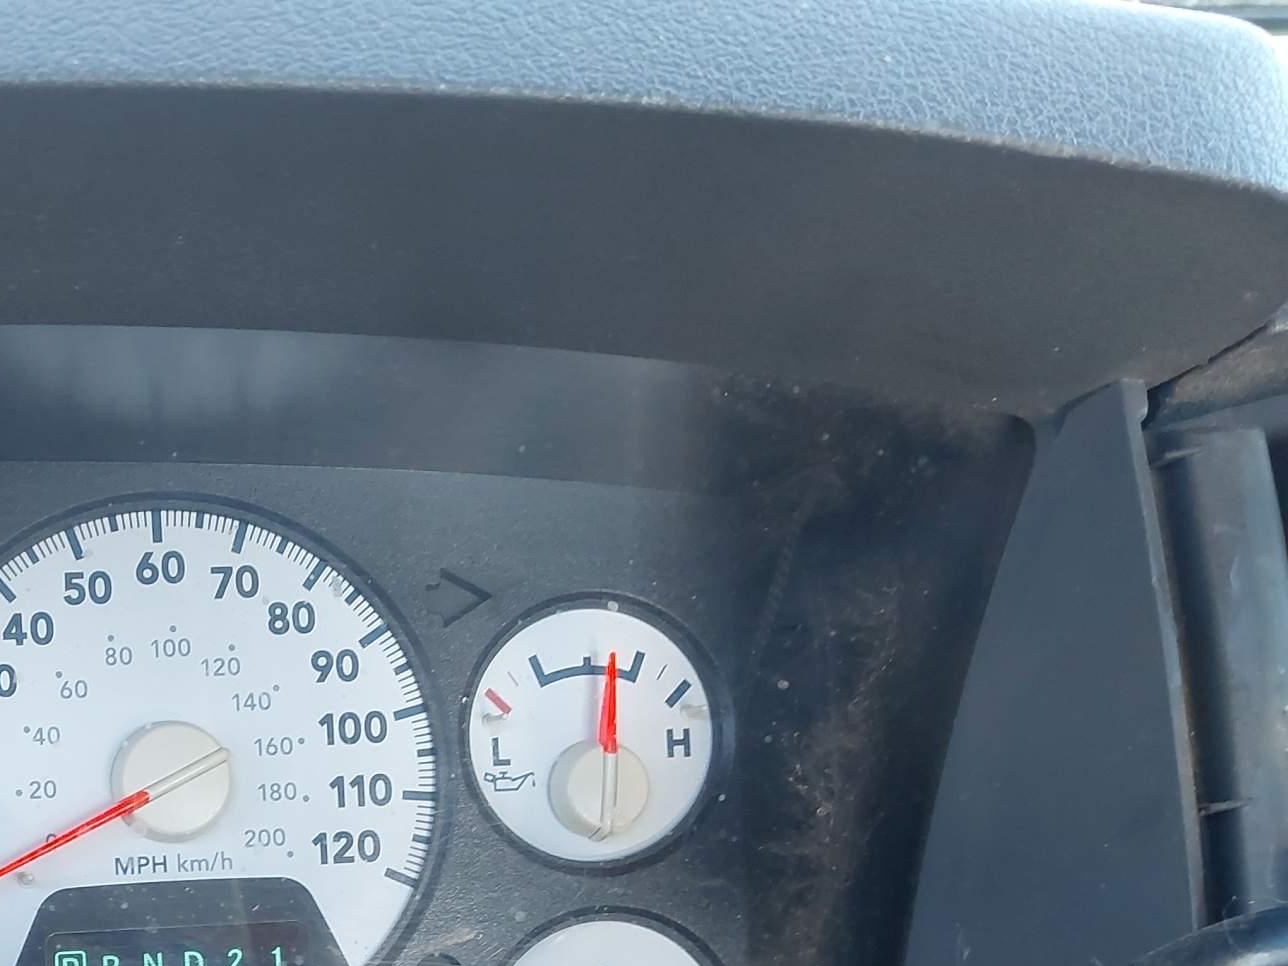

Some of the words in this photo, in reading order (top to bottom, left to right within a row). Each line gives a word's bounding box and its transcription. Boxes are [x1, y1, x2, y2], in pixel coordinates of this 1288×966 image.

[135, 550, 186, 586] 60
[210, 564, 260, 600] 70
[63, 570, 112, 606] 50
[2, 611, 54, 646] 40
[267, 600, 316, 636] 80
[105, 646, 133, 666] 80
[150, 638, 191, 658] 100
[200, 657, 241, 677] 120
[310, 648, 360, 684] 90
[58, 678, 88, 700] 60
[231, 691, 272, 712] 140
[32, 725, 61, 746] 40
[318, 710, 388, 746] 100
[666, 727, 692, 758] H
[253, 736, 293, 757] 160
[491, 736, 511, 767] L
[29, 780, 57, 800] 20
[257, 782, 297, 802] 180
[329, 773, 393, 809] 110
[244, 828, 286, 849] 200
[311, 829, 381, 865] 120
[114, 857, 168, 876] MPH
[177, 850, 234, 877] km/h
